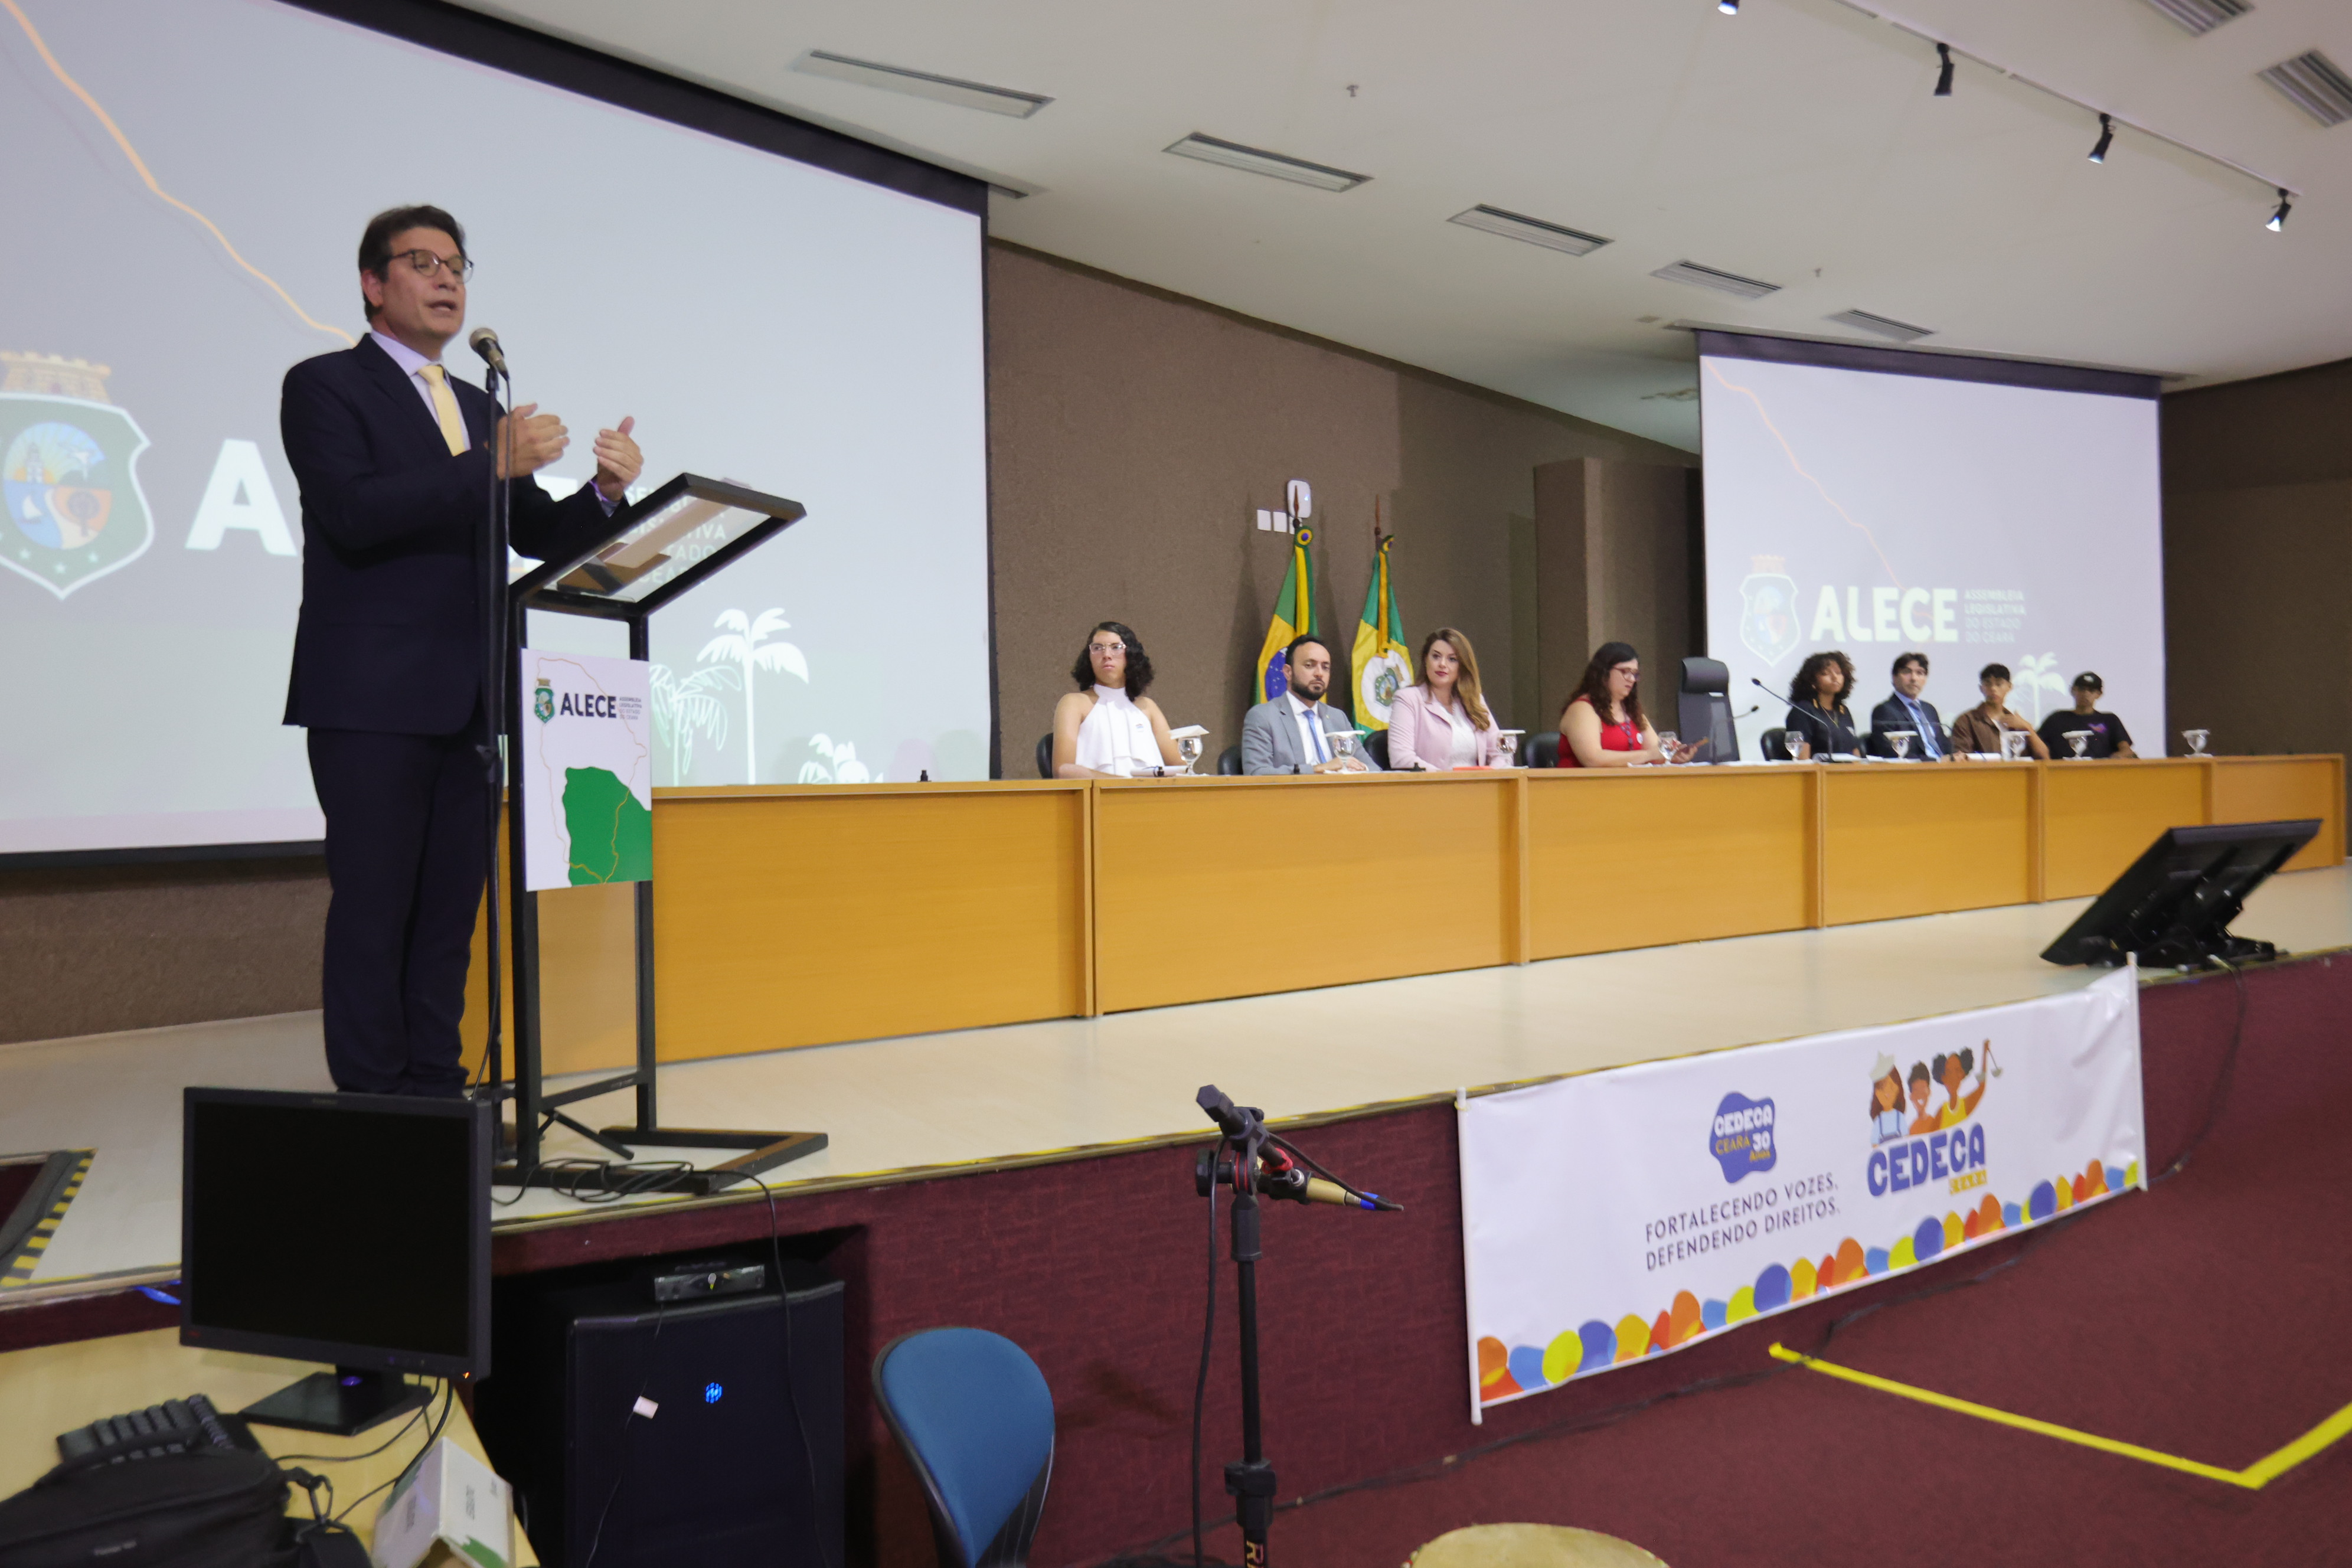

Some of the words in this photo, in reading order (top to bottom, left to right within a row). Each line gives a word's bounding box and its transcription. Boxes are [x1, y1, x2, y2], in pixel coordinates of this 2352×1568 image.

[1809, 584, 1959, 643] ALECE
[560, 692, 616, 718] ALECE
[1714, 1104, 1773, 1138] CEDECA
[1752, 1130, 1770, 1152] 30
[1867, 1122, 1985, 1197] CEDECA
[1645, 1187, 1778, 1243] FORTALECENDO
[1646, 1219, 1758, 1272] DEFENDENDO
